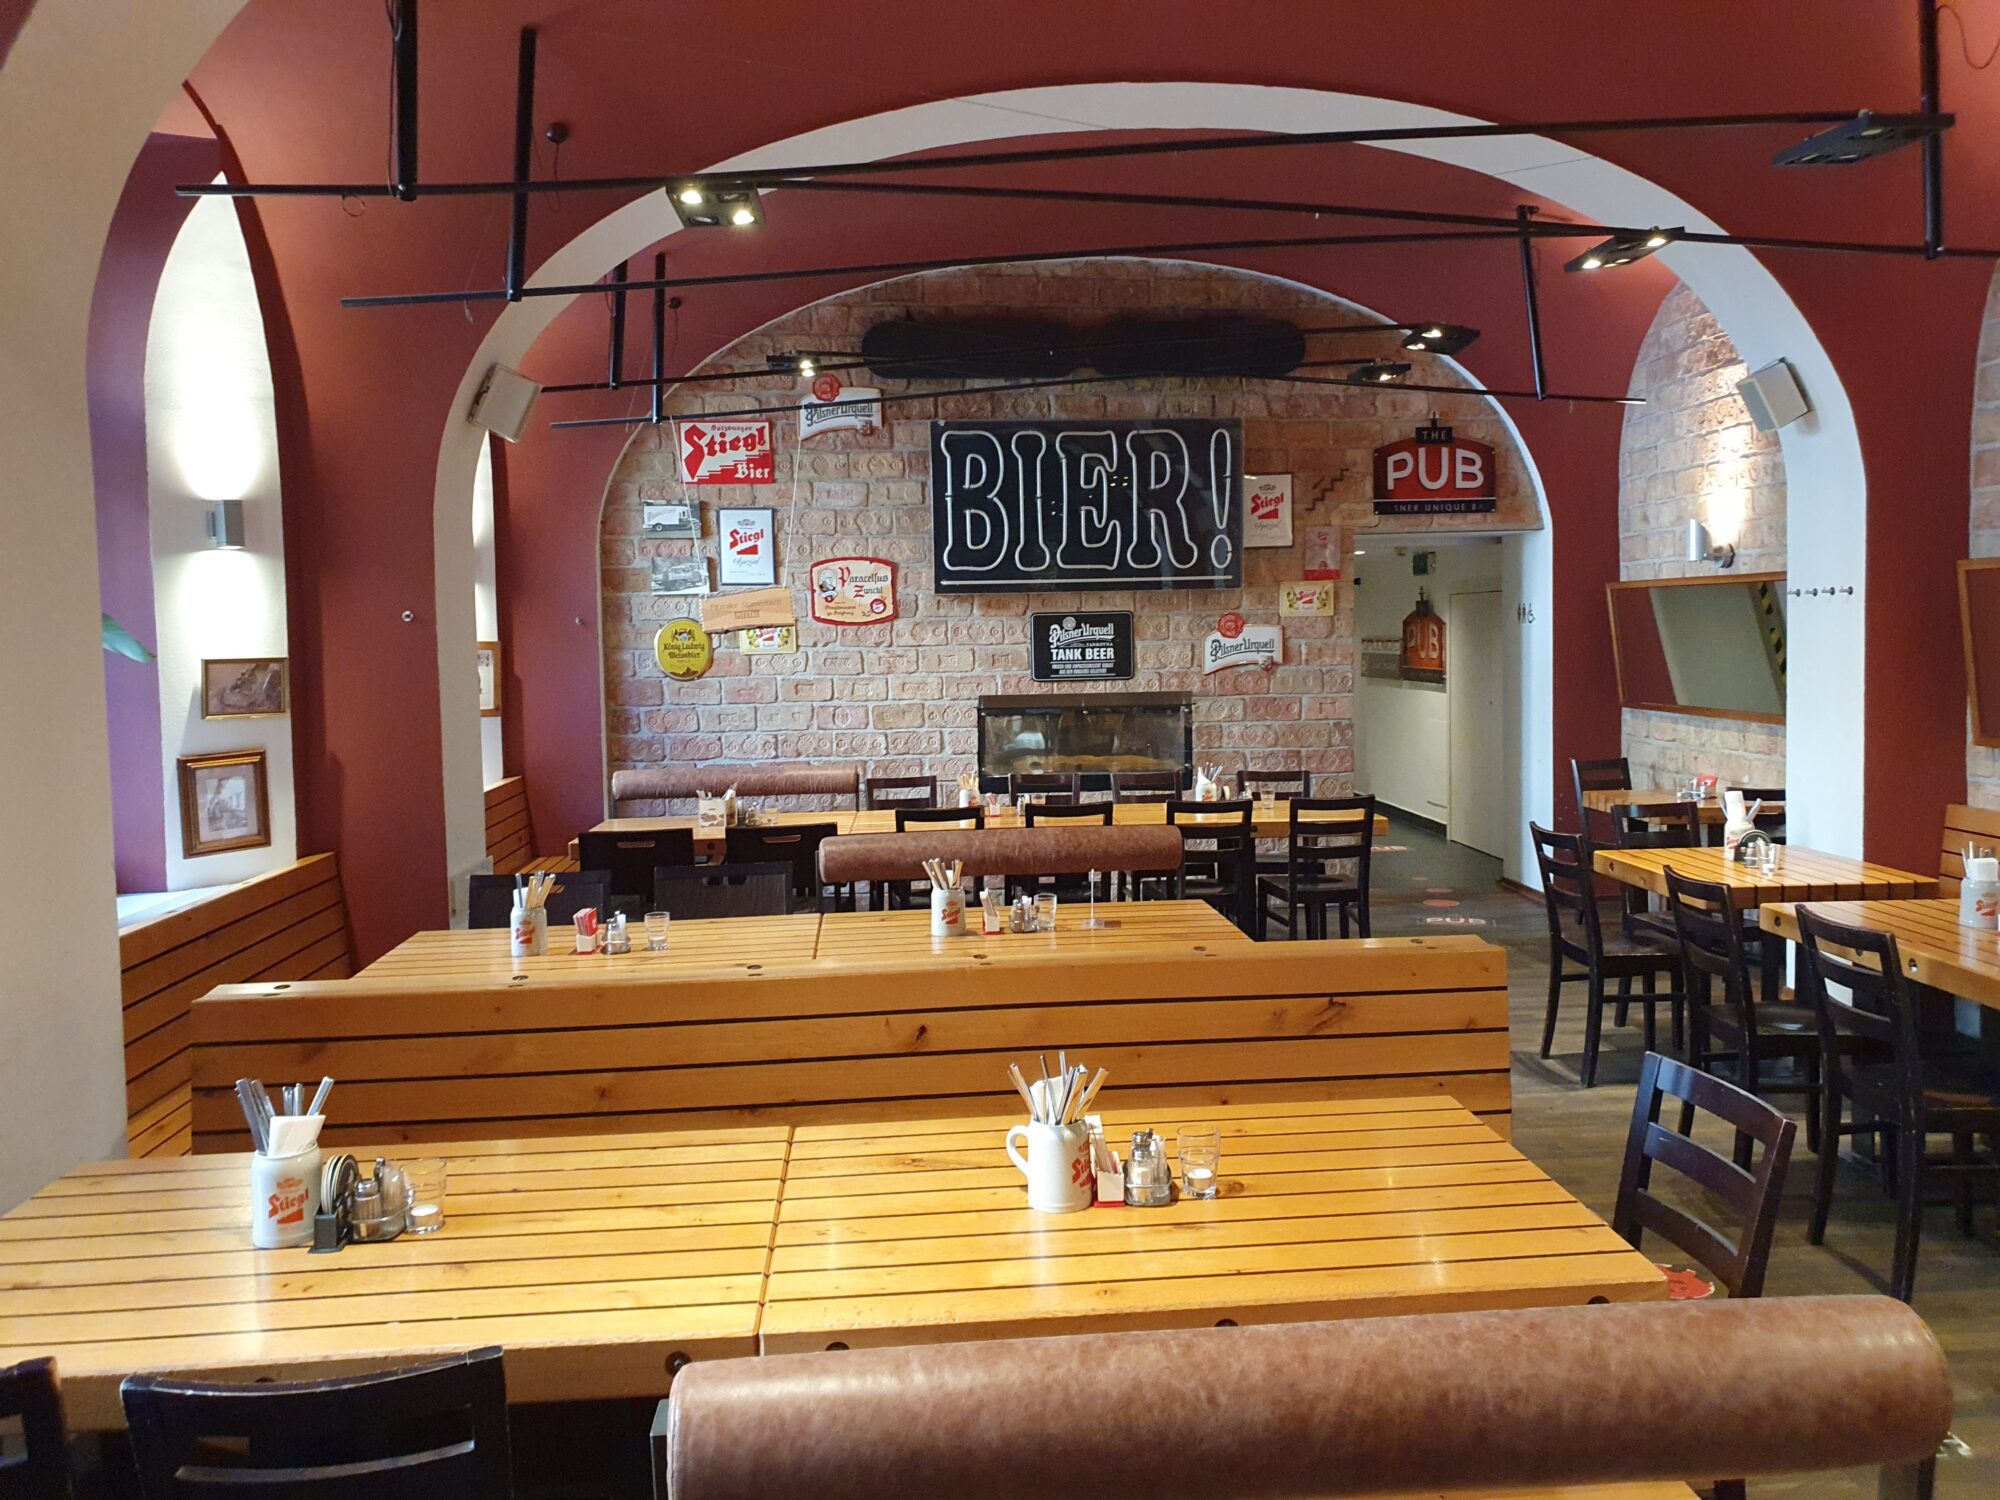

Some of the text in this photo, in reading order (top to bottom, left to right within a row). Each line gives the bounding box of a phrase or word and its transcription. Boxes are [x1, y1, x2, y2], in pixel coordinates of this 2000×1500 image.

[1422, 430, 1447, 440] THE
[684, 424, 766, 480] Stiegl
[735, 463, 769, 479] Bier
[1387, 446, 1484, 490] PUB
[941, 429, 1231, 571] BIER!
[1251, 492, 1284, 515] Stiegl
[1425, 503, 1466, 513] UNIQUE
[729, 528, 764, 549] Stiegl
[1049, 622, 1114, 648] Pilsner Urquell
[1050, 647, 1115, 661] TANK BEER
[1210, 637, 1275, 662] Pilsner Urquell
[268, 1188, 309, 1218] Stiegl
